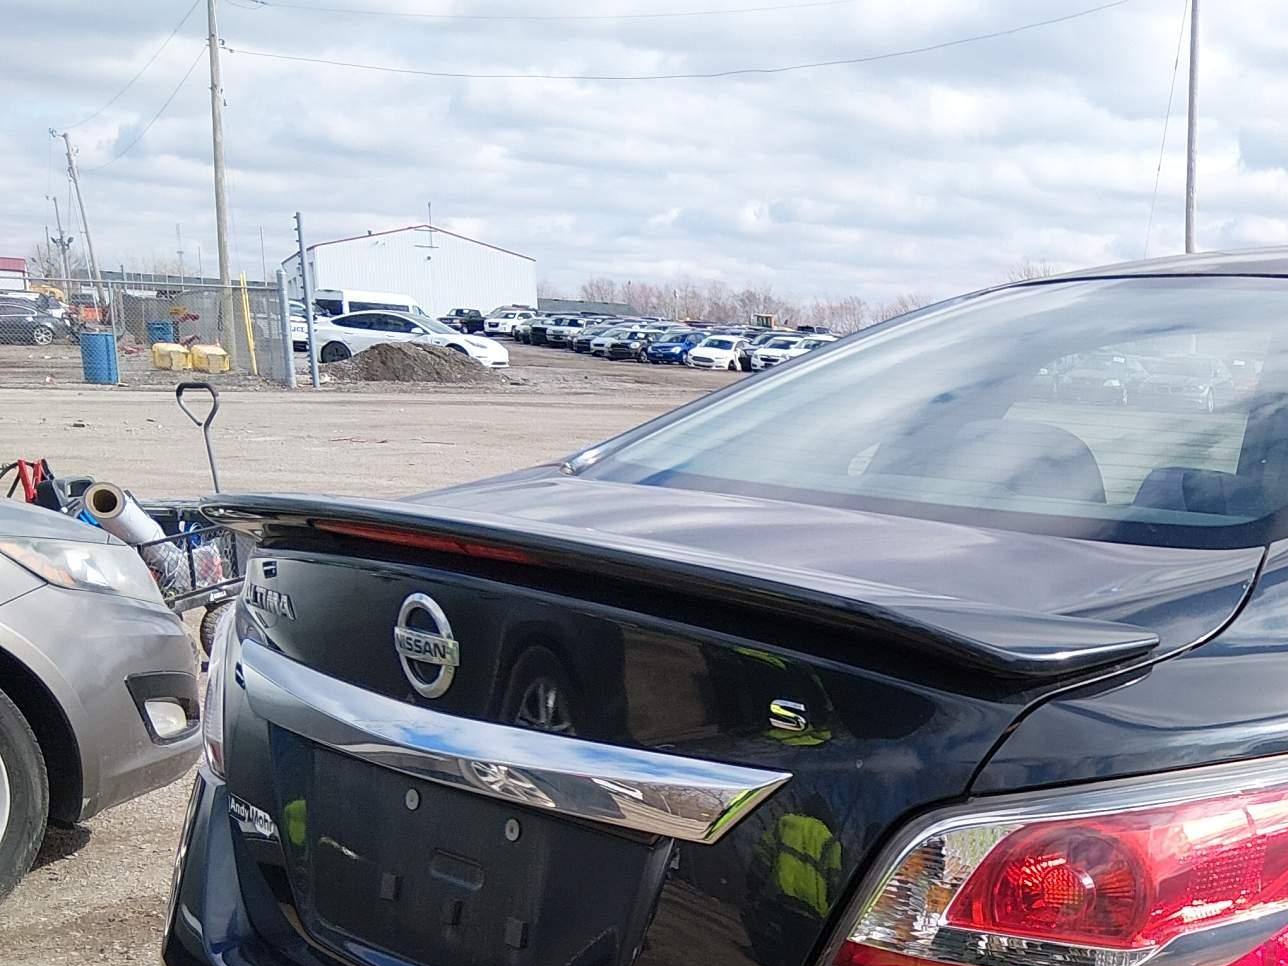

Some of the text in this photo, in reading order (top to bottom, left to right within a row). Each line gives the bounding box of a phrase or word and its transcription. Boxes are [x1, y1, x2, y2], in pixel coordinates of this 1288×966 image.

[396, 633, 447, 659] NISSAN
[769, 699, 806, 731] S
[230, 797, 249, 822] Andy
